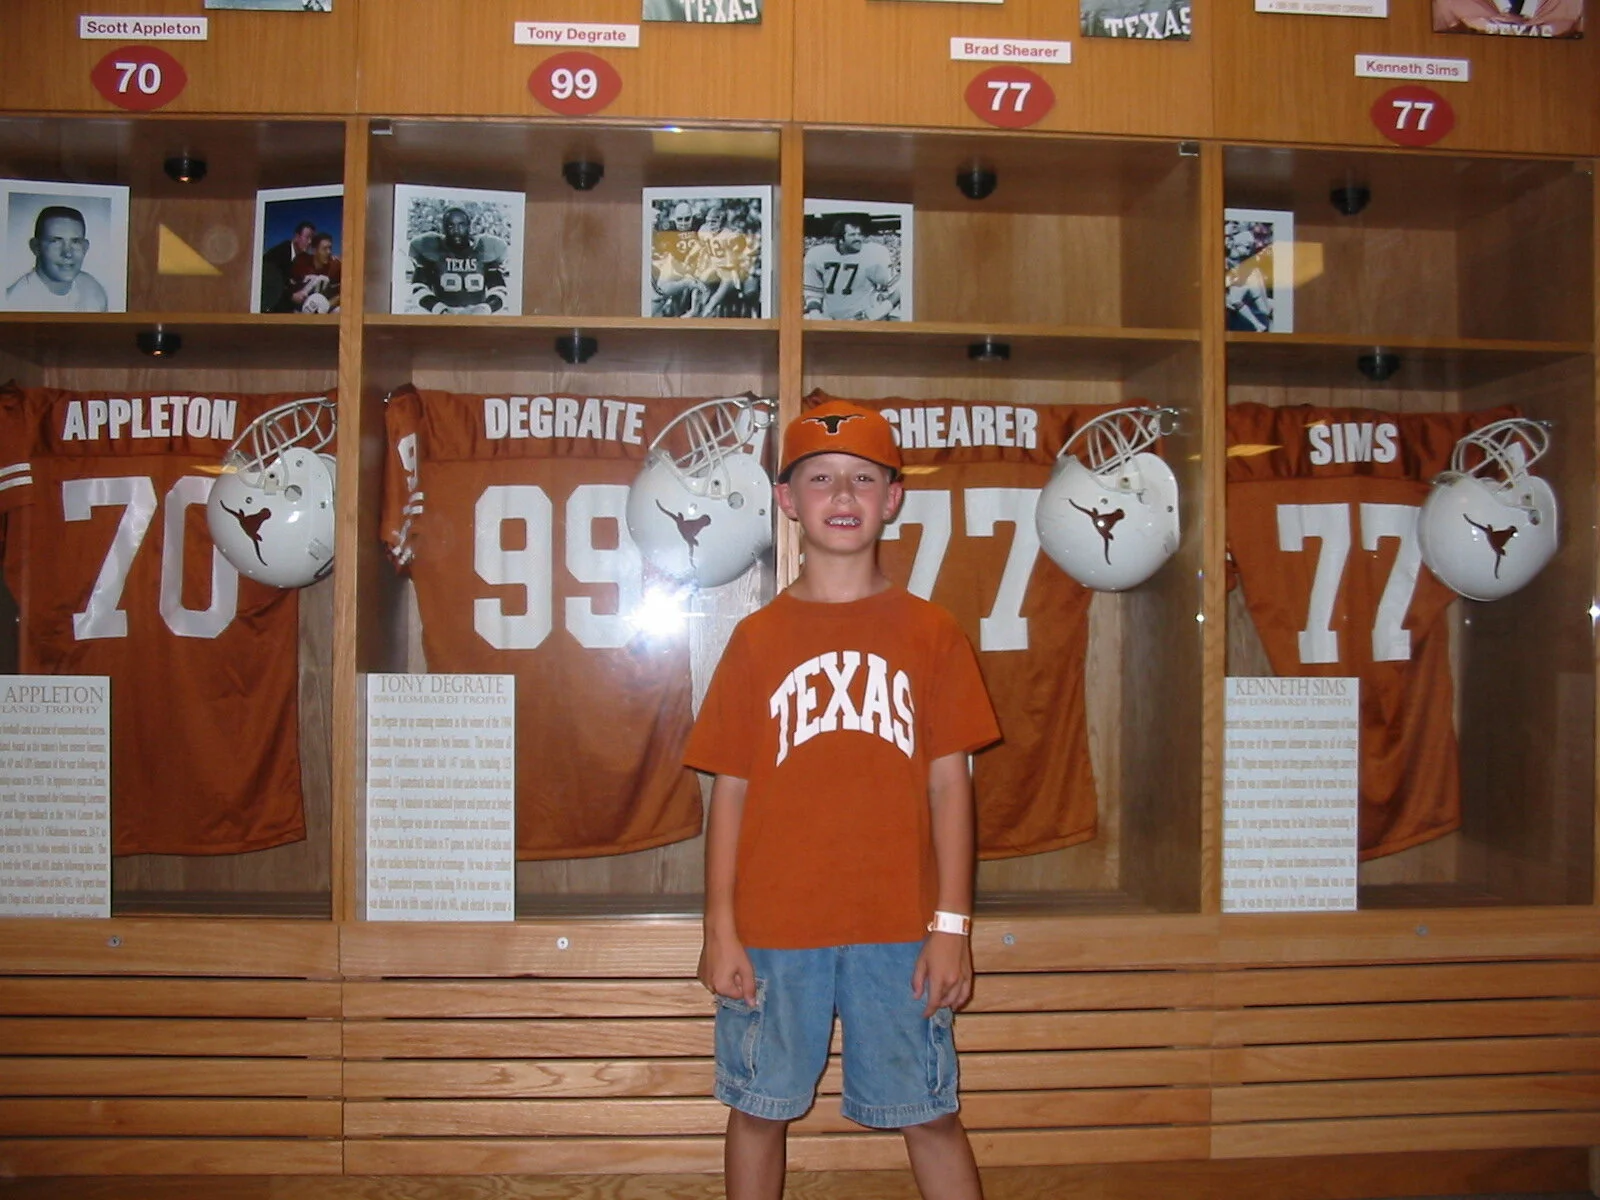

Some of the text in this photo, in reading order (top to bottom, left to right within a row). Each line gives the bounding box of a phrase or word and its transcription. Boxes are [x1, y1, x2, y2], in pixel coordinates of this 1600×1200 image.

[679, 0, 758, 22] TEXAS
[87, 21, 201, 37] Scott Appleton
[527, 27, 627, 43] Tony Degrate
[964, 43, 1059, 58] Brad Shearer
[115, 62, 161, 94] 70
[550, 68, 598, 100] 99
[1366, 60, 1459, 77] Kenneth Sims
[987, 81, 1031, 112] 77
[1392, 100, 1434, 131] 77
[445, 257, 478, 272] TEXAS
[824, 262, 859, 295] 77
[62, 396, 237, 441] APPLETON
[484, 396, 645, 445] DEGRATE
[1308, 422, 1398, 466] SIMS
[62, 475, 239, 640] 70
[473, 484, 642, 650] 99
[881, 487, 1043, 652] 77
[1277, 502, 1423, 664] 77
[4, 686, 105, 703] APPLETON
[380, 675, 505, 694] TONY DEGRATE
[1235, 679, 1347, 696] KENNETH SIMS
[46, 705, 100, 714] TROPHY
[769, 651, 915, 768] TEXAS
